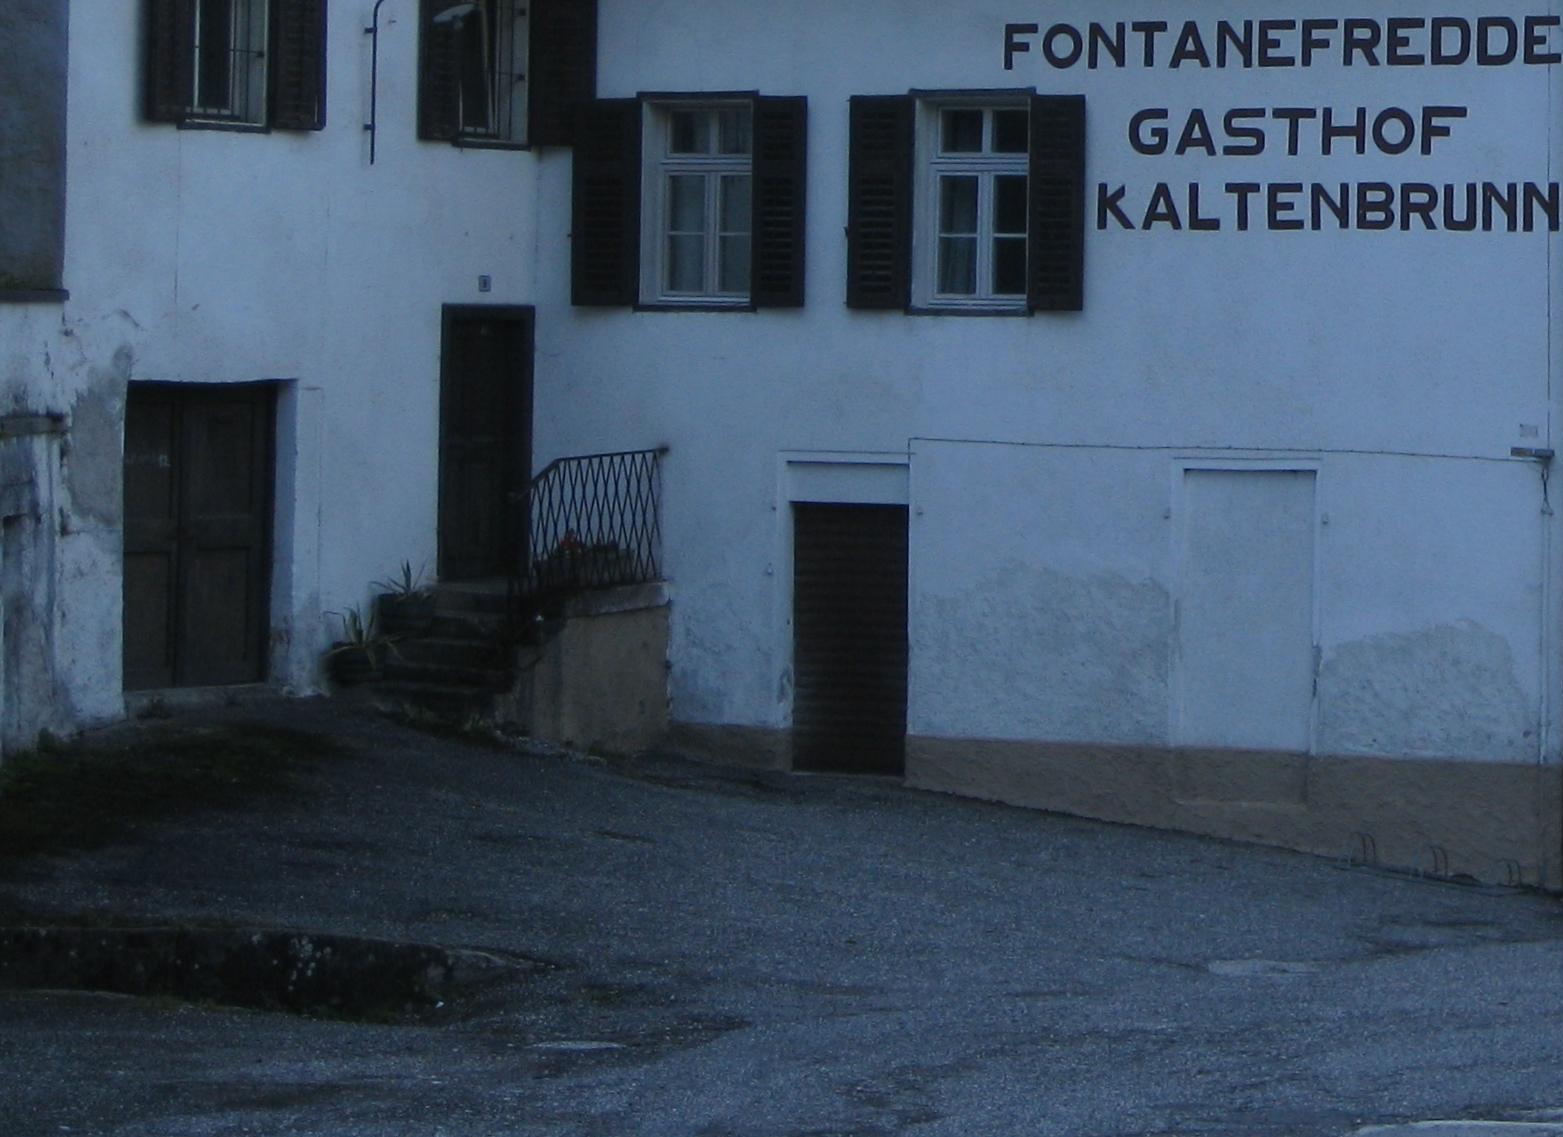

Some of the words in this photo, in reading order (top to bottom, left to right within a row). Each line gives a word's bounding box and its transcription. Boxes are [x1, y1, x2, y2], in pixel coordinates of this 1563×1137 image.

[1003, 15, 1563, 70] FONTANEFREDDE
[1128, 106, 1468, 156] GASTHOF
[1096, 182, 1561, 232] KALTENBRUNN
